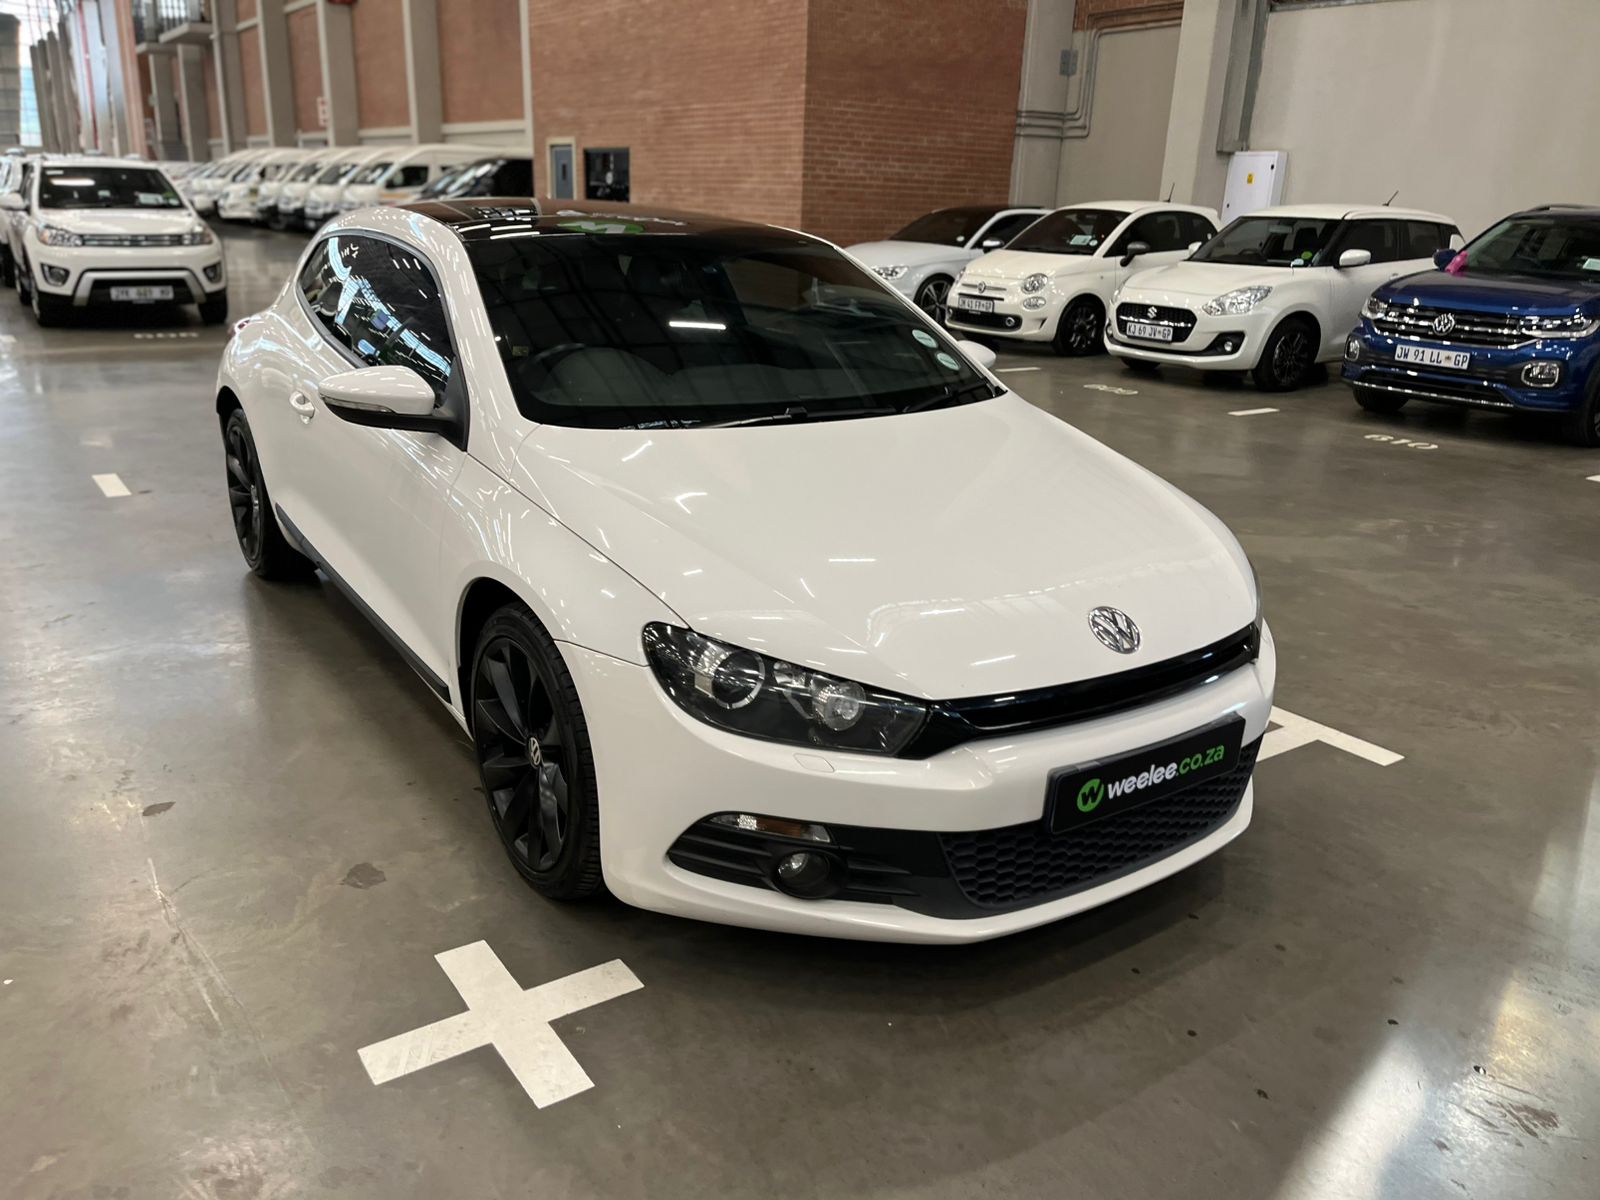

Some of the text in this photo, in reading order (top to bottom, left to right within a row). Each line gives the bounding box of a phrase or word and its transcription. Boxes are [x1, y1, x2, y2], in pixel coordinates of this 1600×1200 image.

[1127, 323, 1137, 335] KJ
[1138, 325, 1147, 336] 69
[1161, 328, 1172, 340] GP
[1396, 346, 1468, 367] JW 91 LL GP
[1364, 434, 1438, 449] 610
[1107, 745, 1225, 799] weelee.co.za
